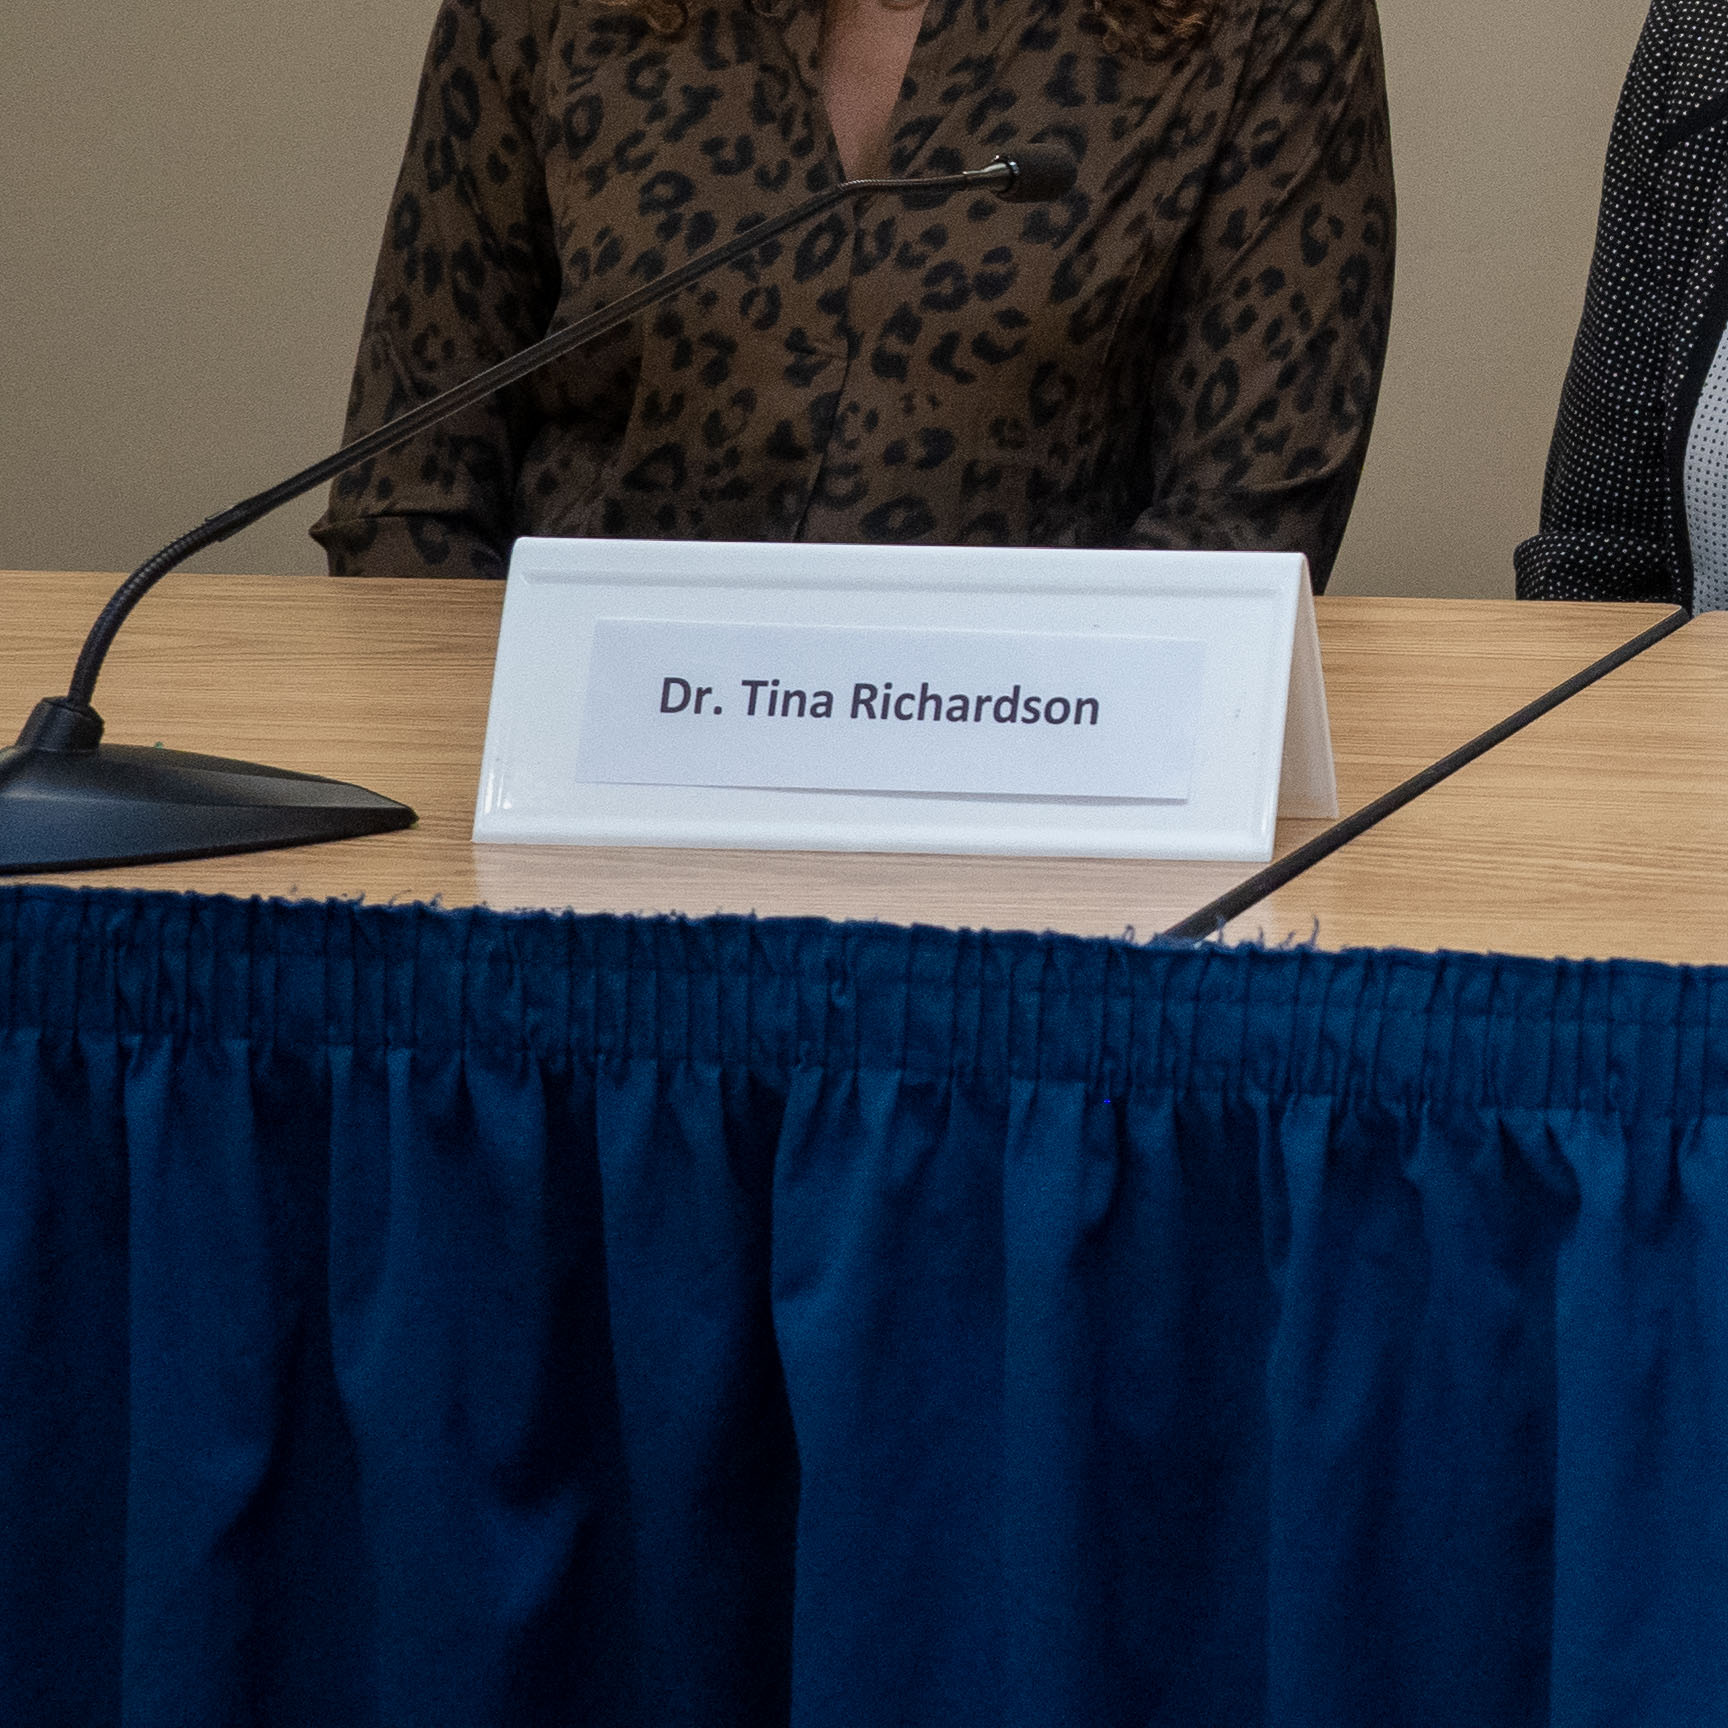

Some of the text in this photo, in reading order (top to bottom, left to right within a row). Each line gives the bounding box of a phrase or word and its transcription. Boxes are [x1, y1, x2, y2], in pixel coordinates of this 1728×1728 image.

[659, 677, 1100, 726] Dr. Tina Richardson
